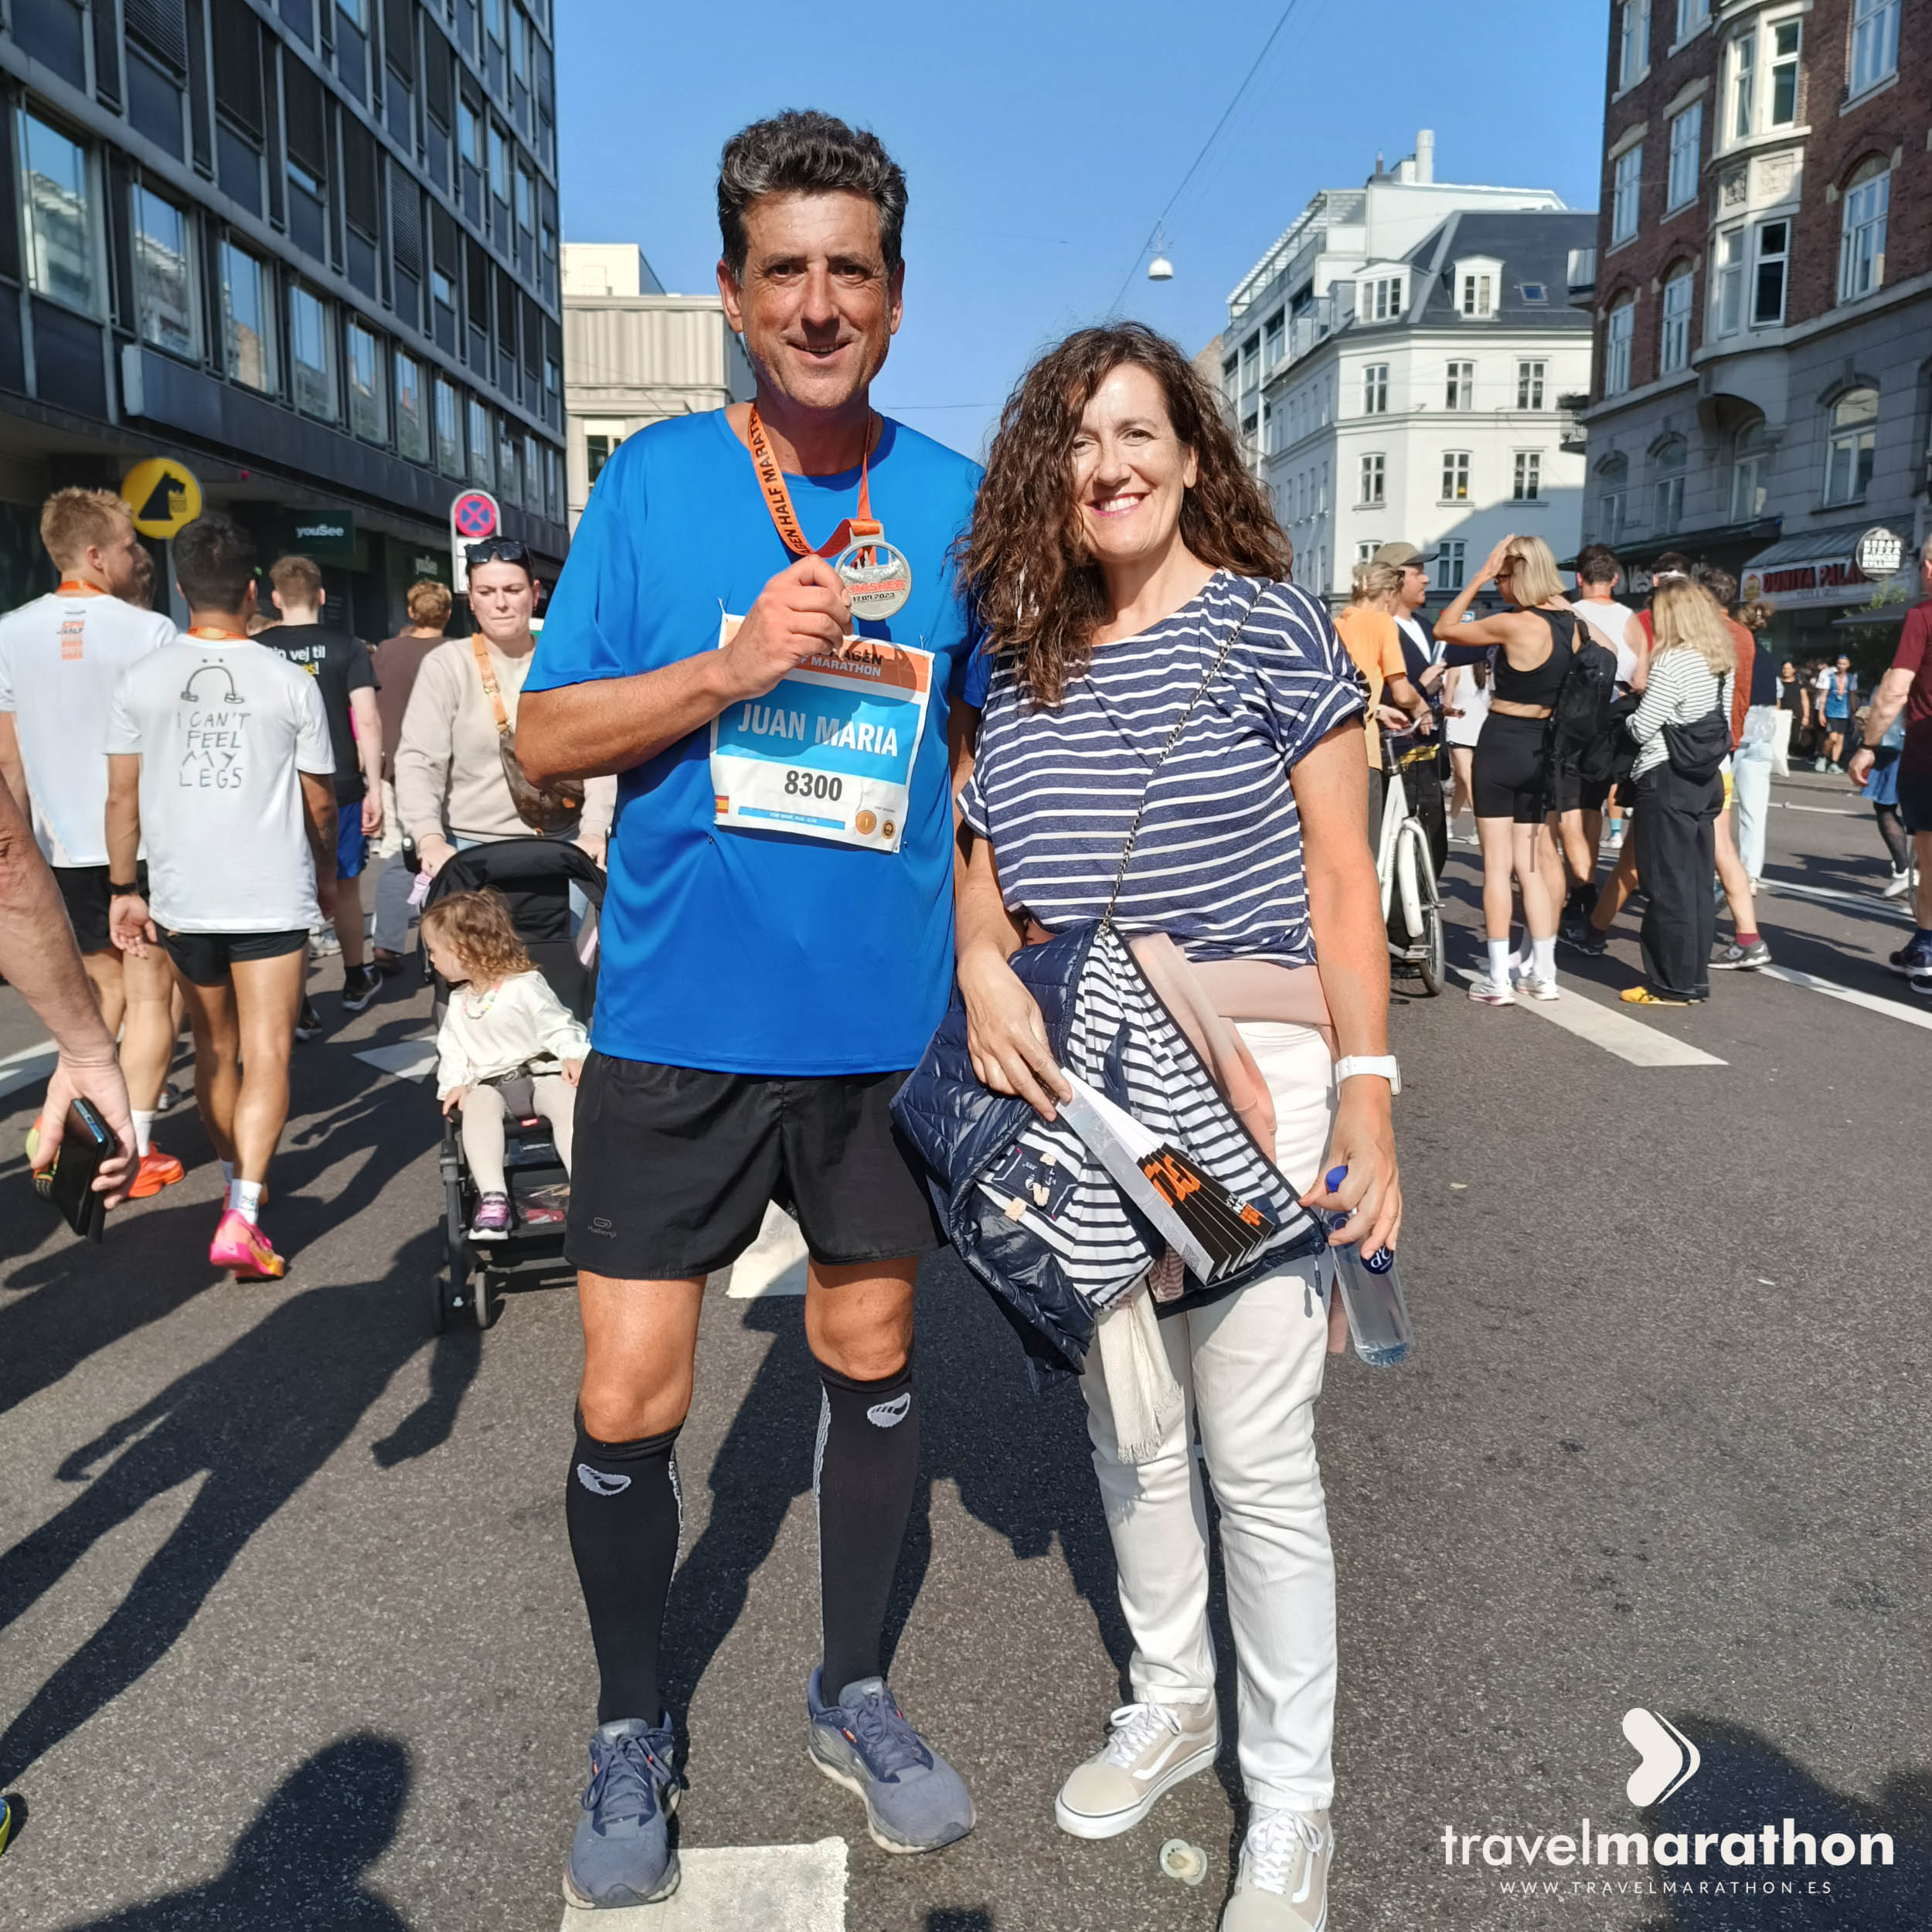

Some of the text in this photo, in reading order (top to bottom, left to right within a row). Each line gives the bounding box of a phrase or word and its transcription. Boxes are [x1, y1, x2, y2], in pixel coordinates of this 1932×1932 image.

[747, 412, 779, 485] MARATH
[767, 486, 794, 526] HALF
[296, 523, 345, 539] youSee
[289, 645, 310, 662] vej
[311, 645, 326, 658] til
[811, 656, 882, 677] MARATHON
[176, 711, 252, 730] I CAN'T
[737, 703, 898, 757] JUAN MARIA
[187, 730, 242, 749] FEEL
[182, 750, 237, 768] MY
[179, 767, 243, 789] LEGS
[784, 770, 843, 801] 8300
